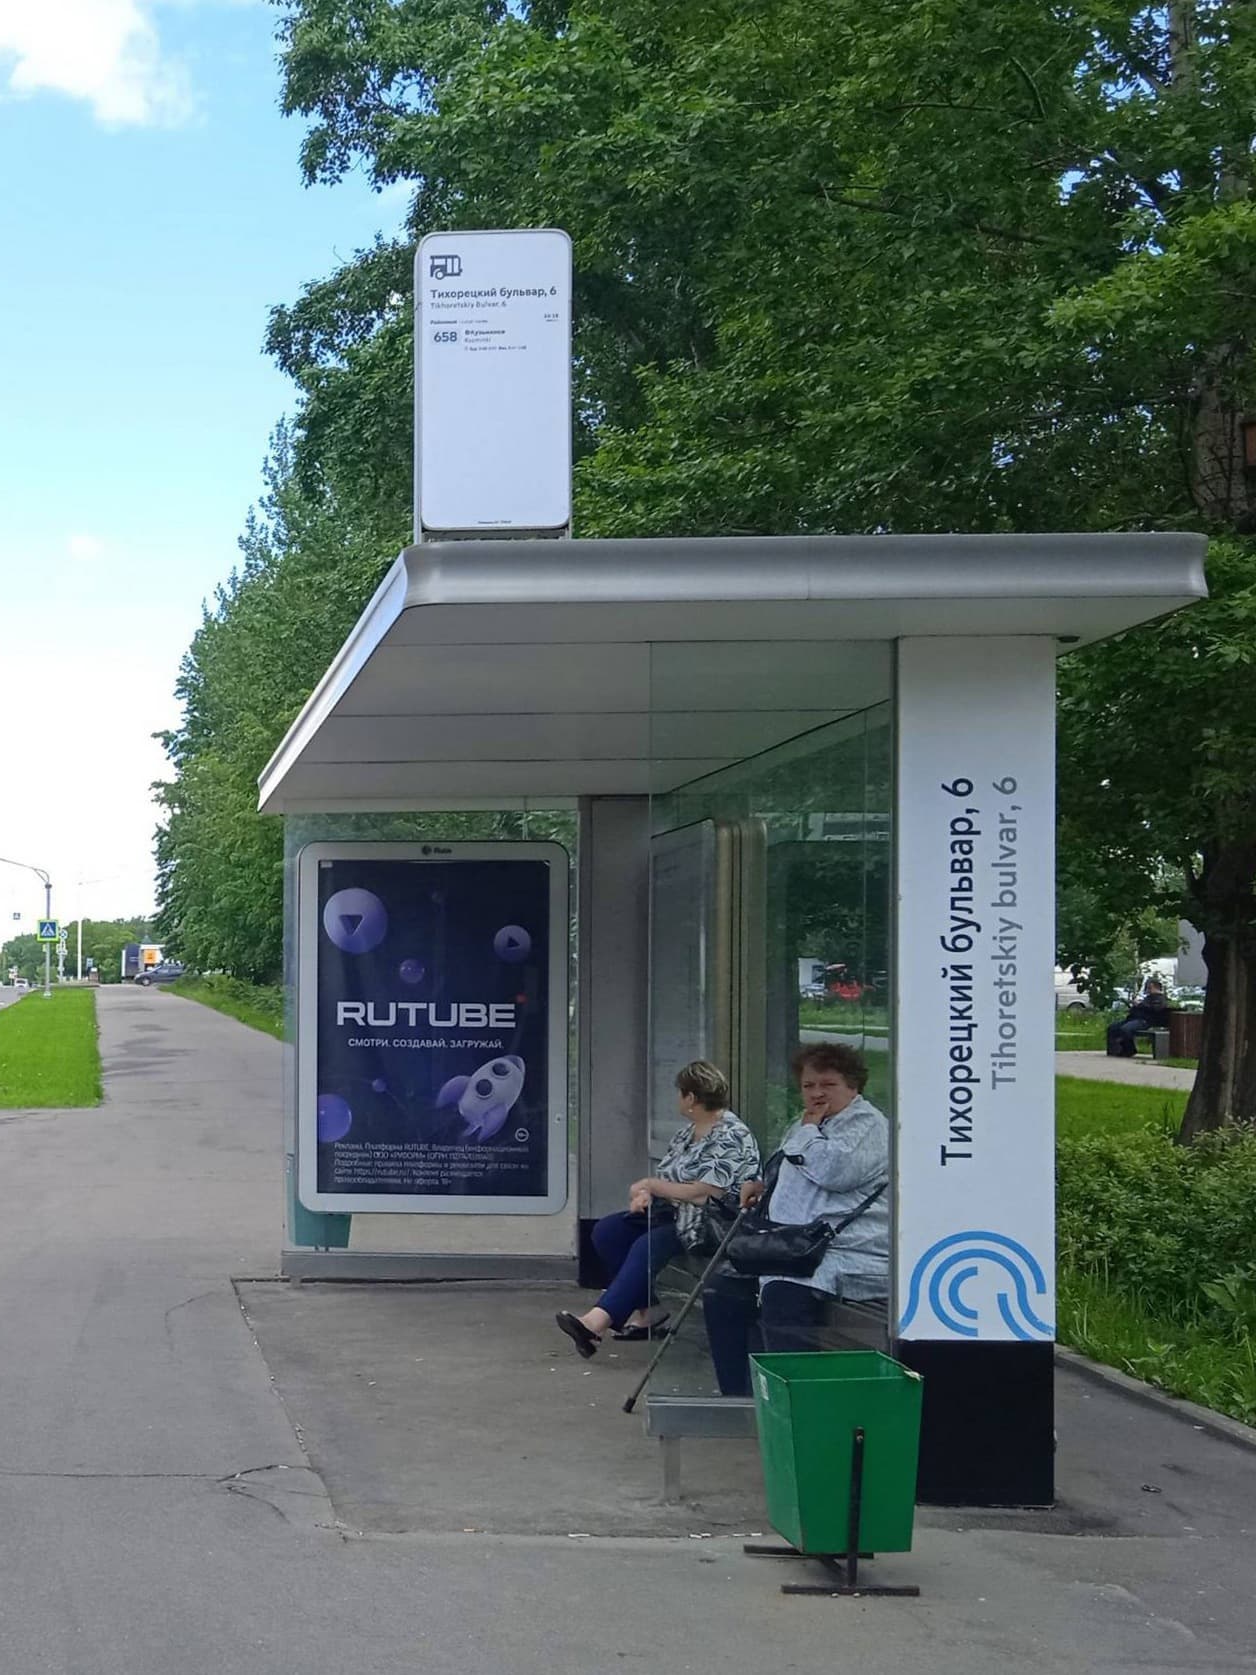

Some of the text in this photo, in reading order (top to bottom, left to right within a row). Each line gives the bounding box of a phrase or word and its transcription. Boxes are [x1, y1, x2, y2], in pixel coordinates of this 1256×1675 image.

[429, 286, 557, 300] Тихорецкий бульвар, 6
[433, 331, 458, 343] 658
[990, 776, 1023, 1091] Tihoretskiy bulvar, 6
[940, 777, 982, 1167] Тихорецкий бульвар, 6
[336, 1001, 517, 1028] RUTUBE
[348, 1038, 504, 1050] СМОТРИ. СОЗДАВАЙ. ЗАГРУЖАЙ.
